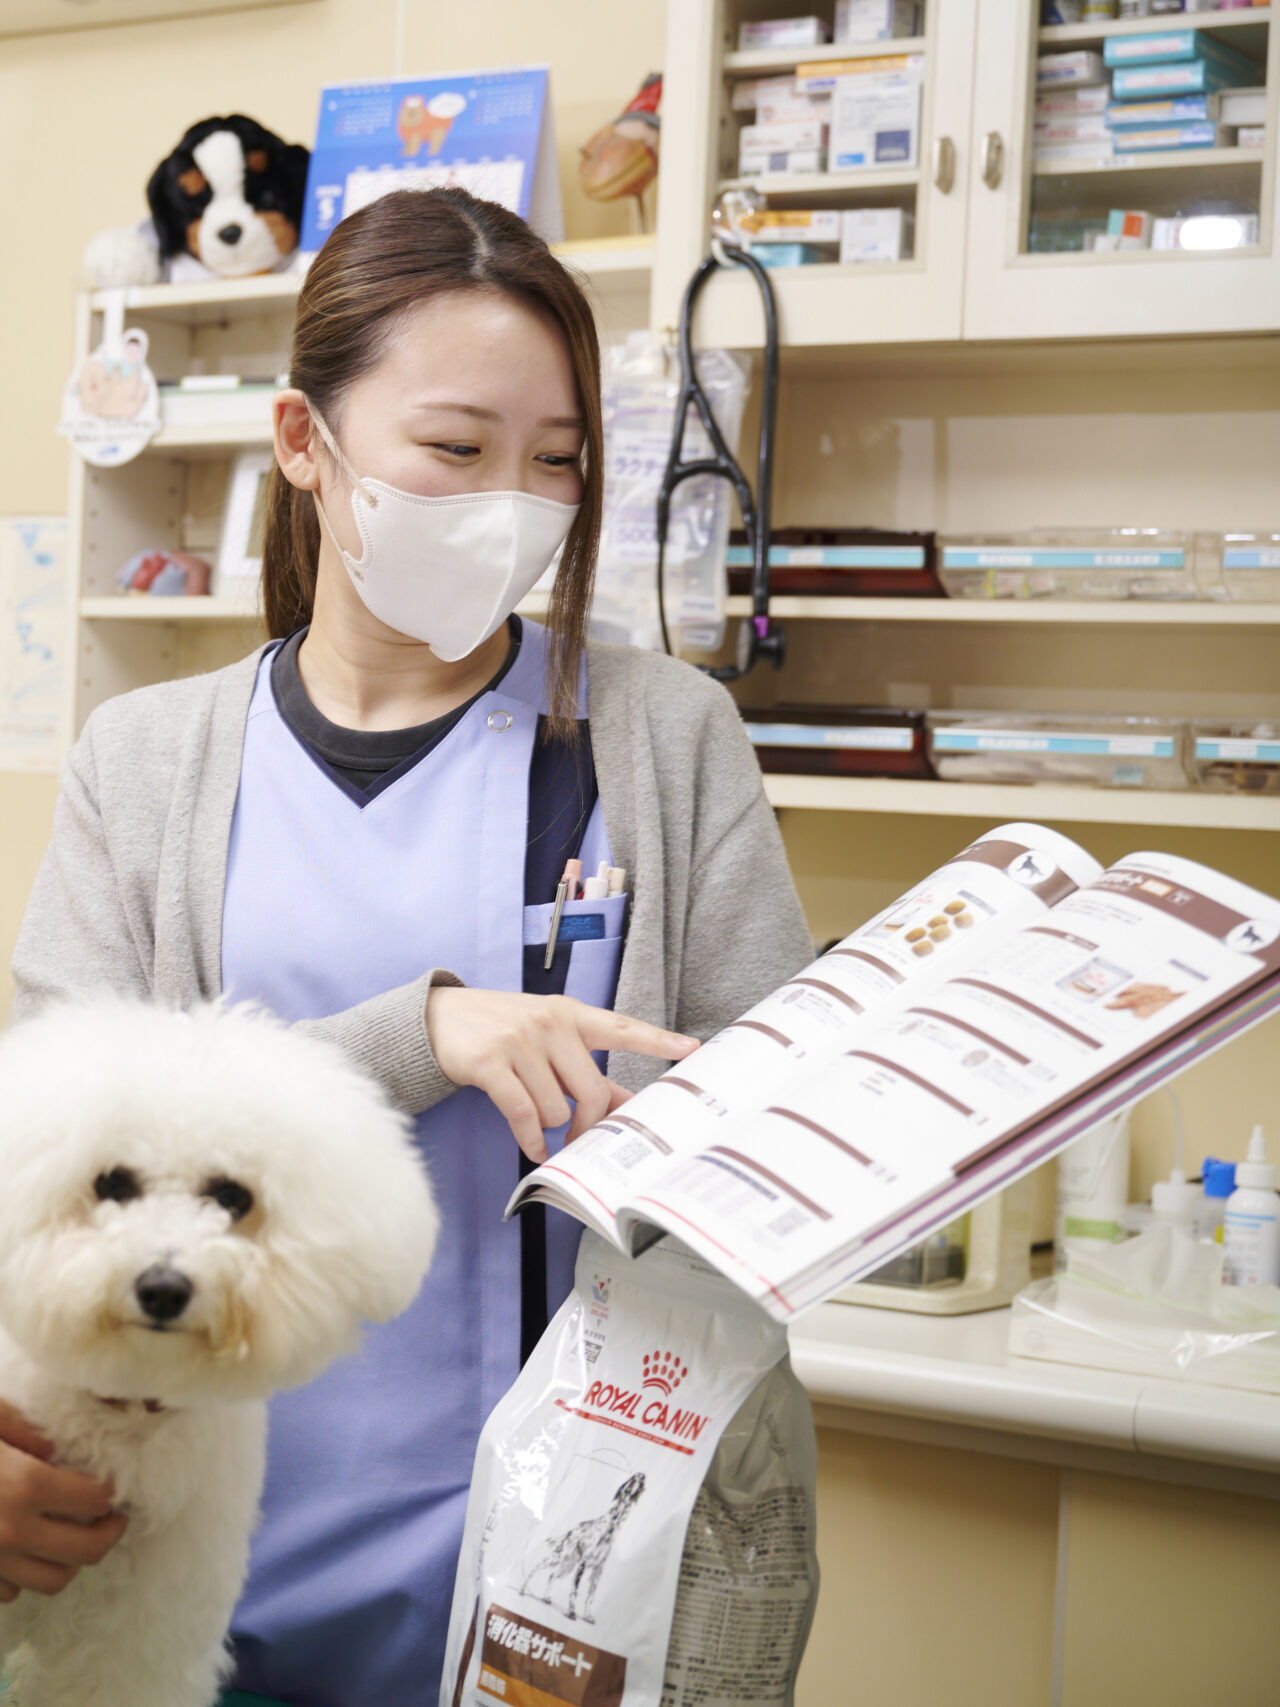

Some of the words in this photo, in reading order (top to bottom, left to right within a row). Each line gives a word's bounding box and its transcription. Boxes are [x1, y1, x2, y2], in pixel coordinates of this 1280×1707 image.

[584, 1380, 642, 1419] ROYAL
[642, 1401, 708, 1441] CANIN
[487, 1614, 593, 1677] 消化器サポート
